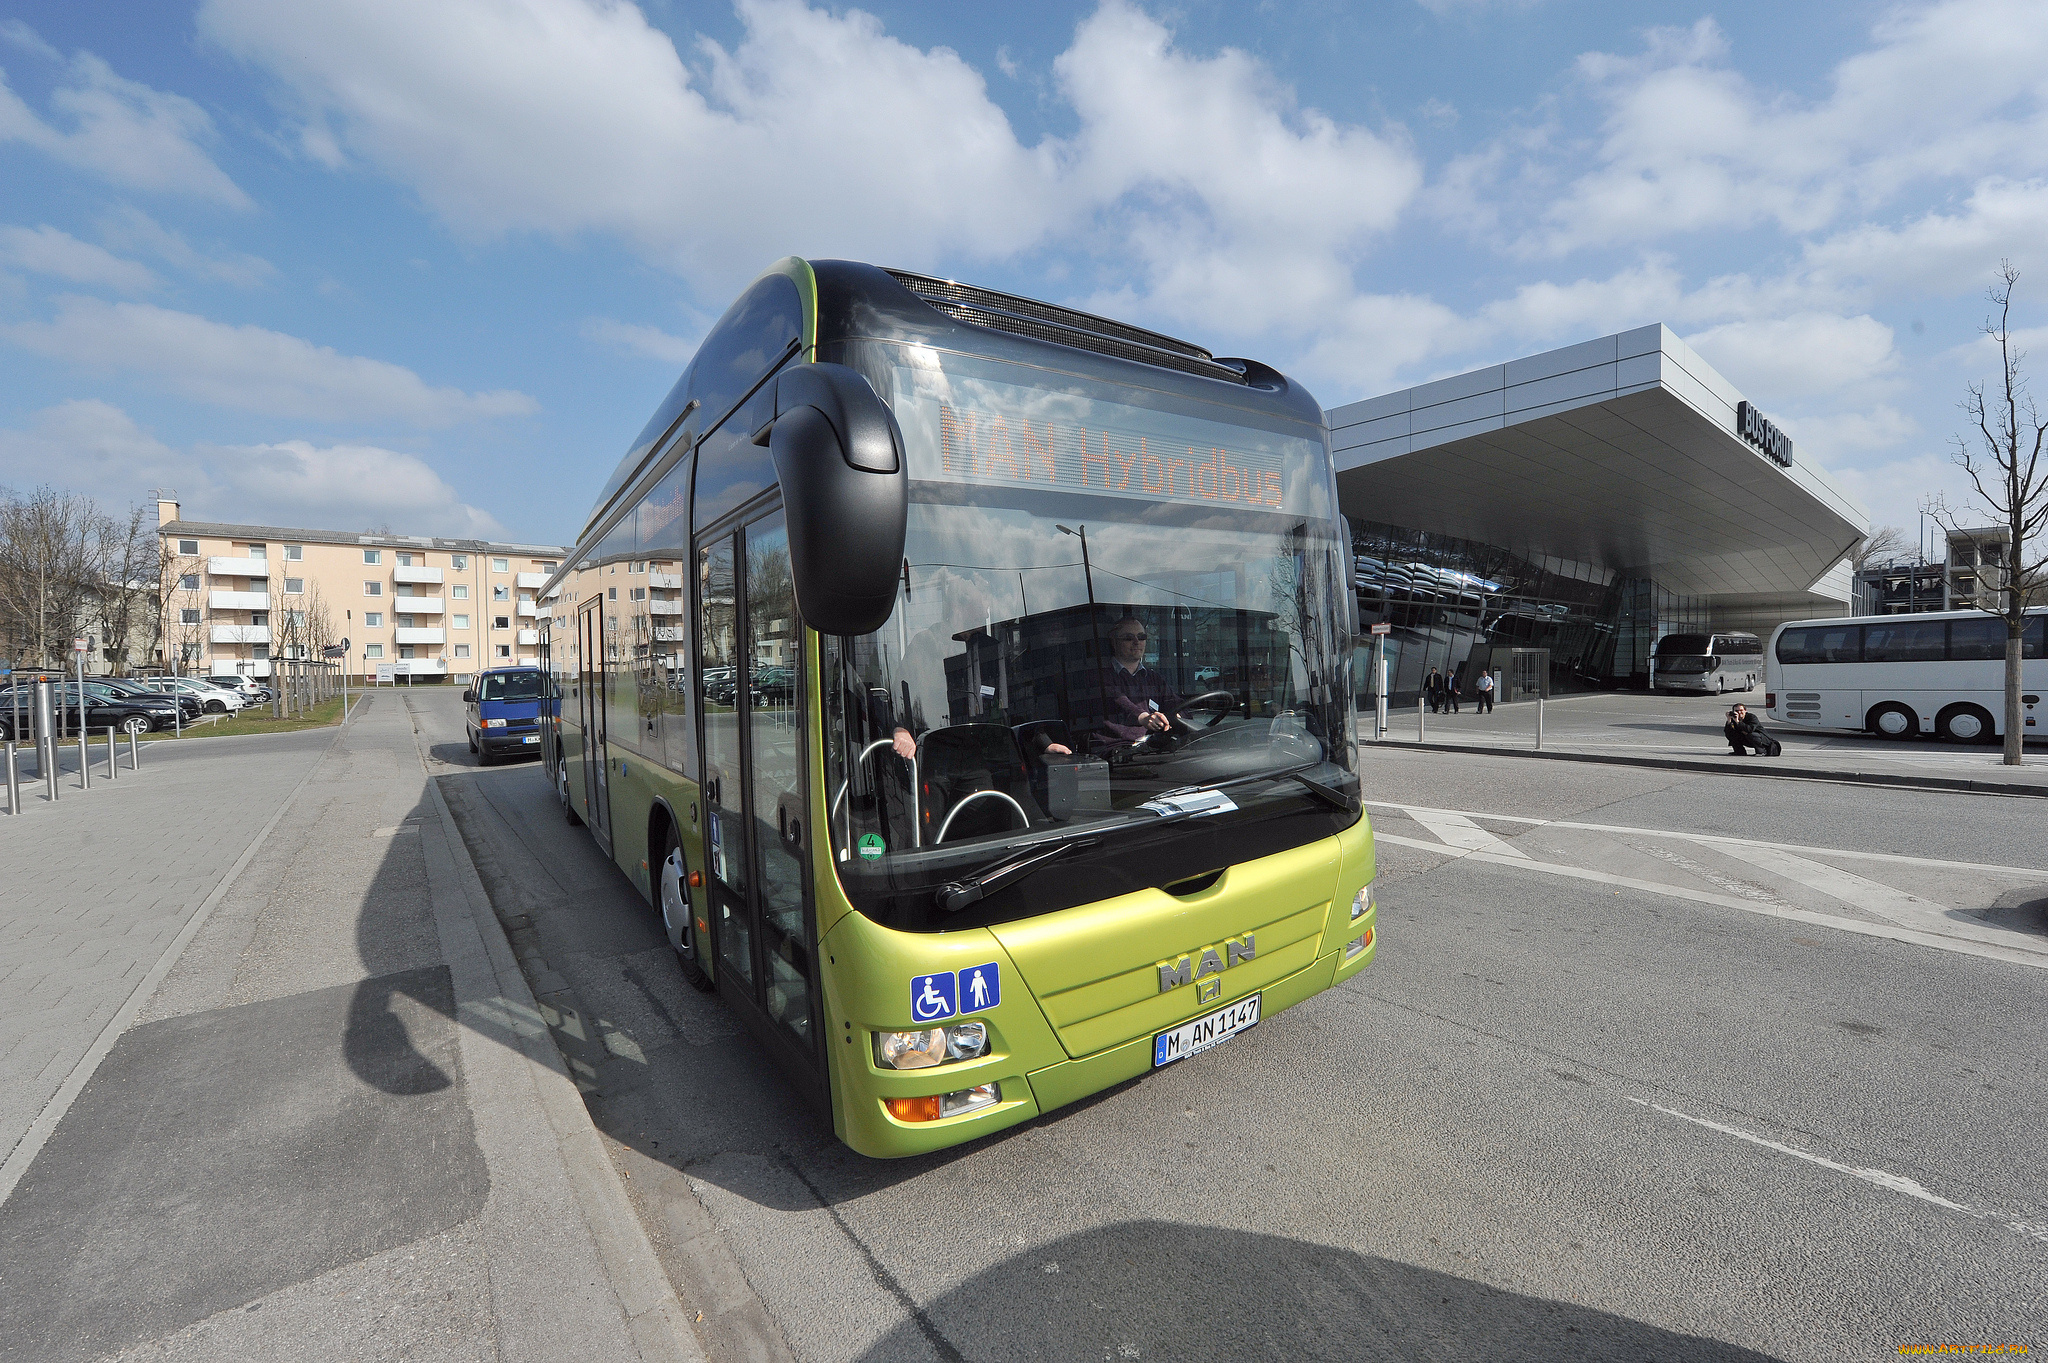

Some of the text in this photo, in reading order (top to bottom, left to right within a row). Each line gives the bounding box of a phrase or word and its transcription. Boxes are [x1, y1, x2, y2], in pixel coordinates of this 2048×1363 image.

[941, 406, 1283, 506] MAN Hybridbus
[1737, 400, 1794, 467] BUS FORUM
[867, 835, 875, 847] 4
[1157, 931, 1256, 993] MAN
[1158, 1051, 1164, 1059] D
[1167, 1032, 1180, 1057] M
